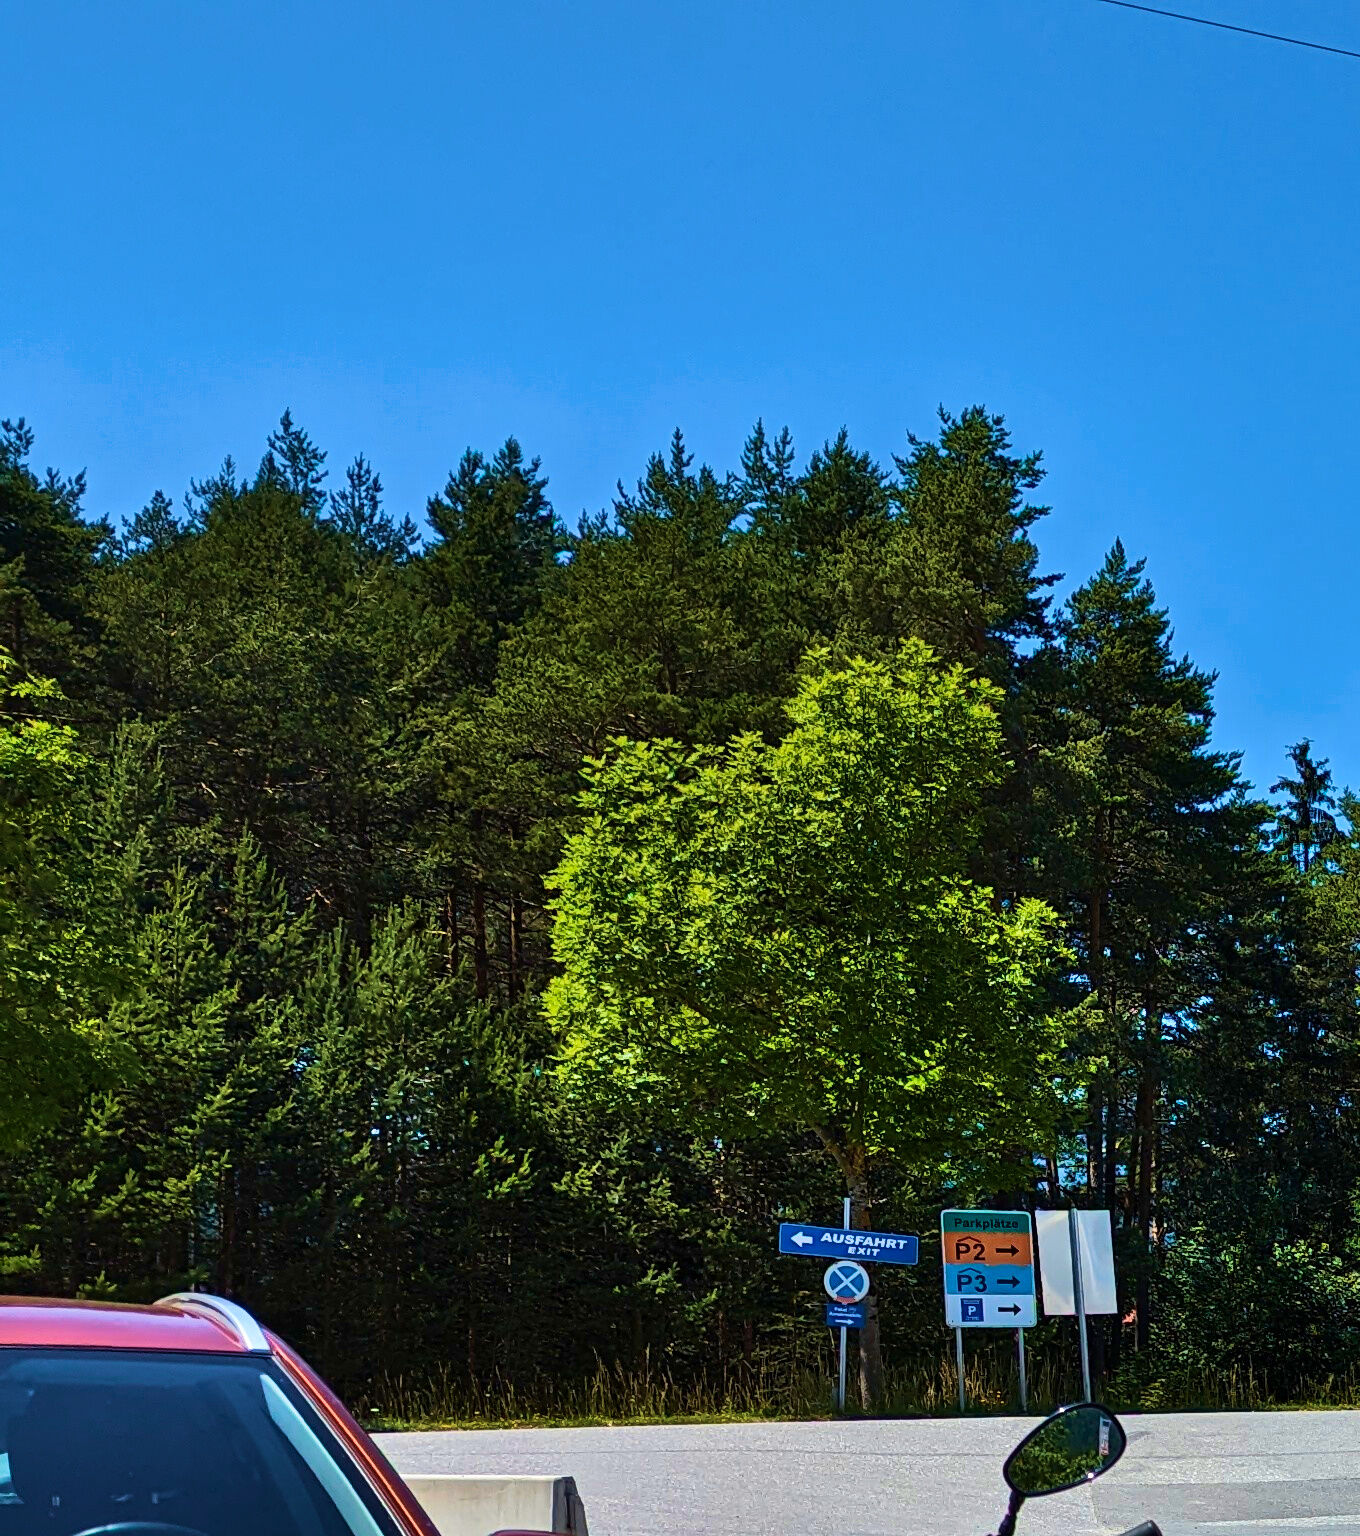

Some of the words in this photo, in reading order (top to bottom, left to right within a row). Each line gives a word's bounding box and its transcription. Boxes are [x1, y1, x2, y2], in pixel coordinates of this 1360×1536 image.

[954, 1218, 1019, 1230] Parkplätze
[820, 1232, 908, 1249] AUSFAHRT
[847, 1246, 880, 1256] EXIT
[955, 1242, 986, 1261] P2
[957, 1274, 987, 1293] P3
[967, 1305, 977, 1316] P
